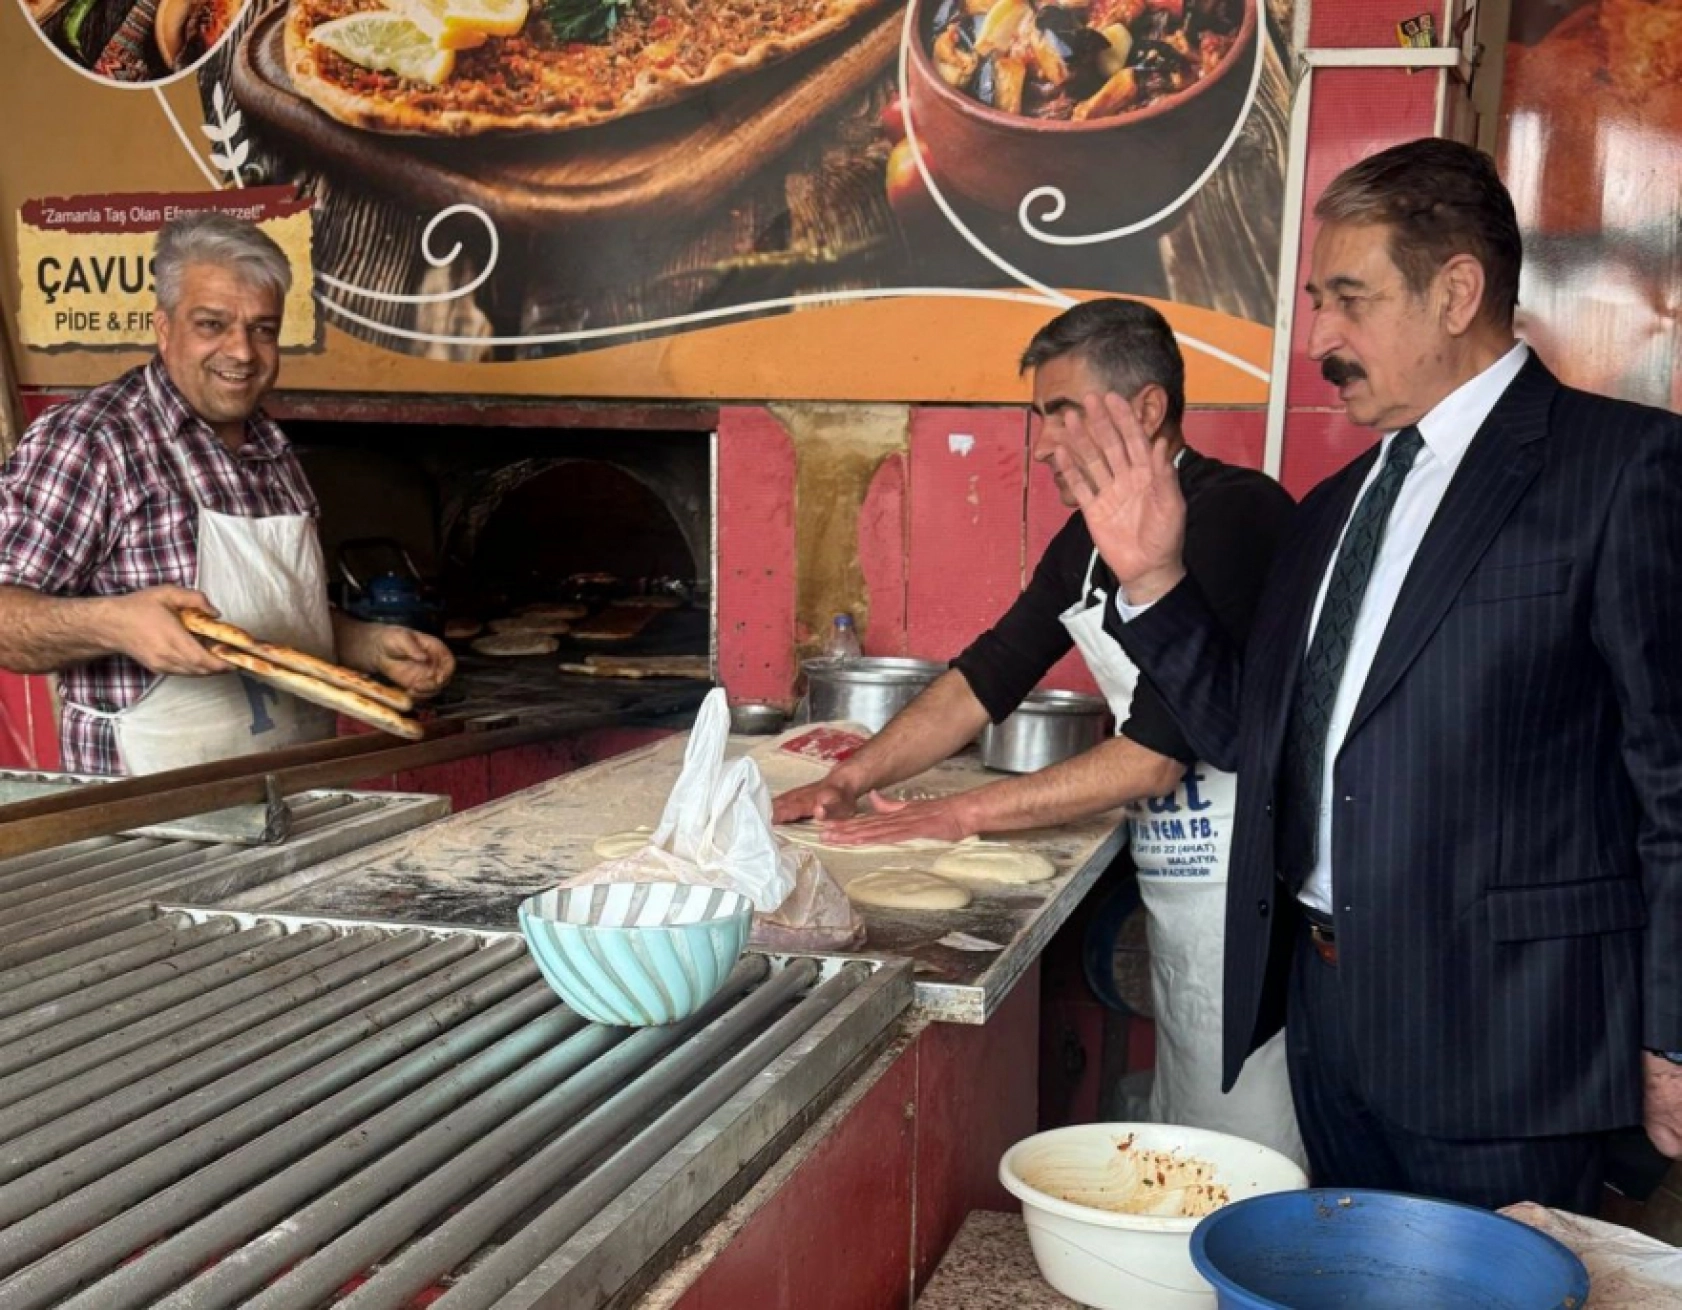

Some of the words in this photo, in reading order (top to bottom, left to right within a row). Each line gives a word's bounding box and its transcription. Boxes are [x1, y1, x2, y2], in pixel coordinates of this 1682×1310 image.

[104, 206, 127, 226] Taş
[129, 205, 161, 222] Olan
[55, 307, 101, 331] PİDE
[106, 310, 121, 331] &
